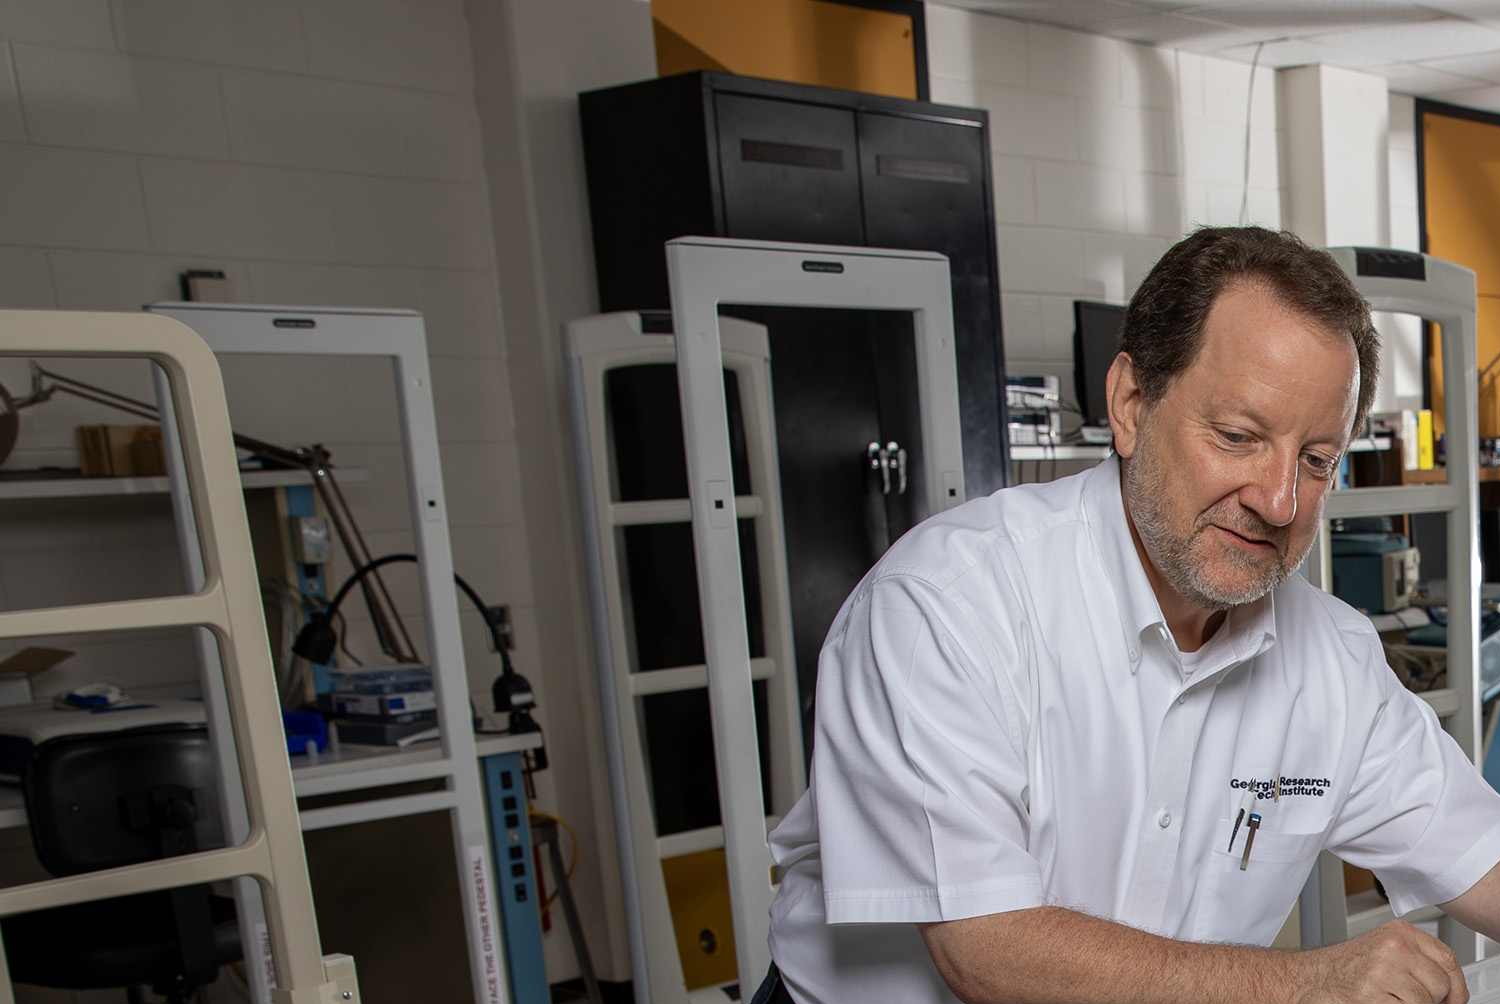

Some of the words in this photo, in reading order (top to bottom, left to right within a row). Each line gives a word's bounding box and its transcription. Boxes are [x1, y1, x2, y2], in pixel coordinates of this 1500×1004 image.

[1230, 778, 1277, 792] Gergi
[1279, 776, 1331, 787] Research
[1278, 786, 1325, 797] Institute
[473, 856, 488, 913] PEDESTAL
[480, 916, 494, 952] OTHER
[484, 953, 496, 975] THE
[487, 976, 500, 1004] FACE
